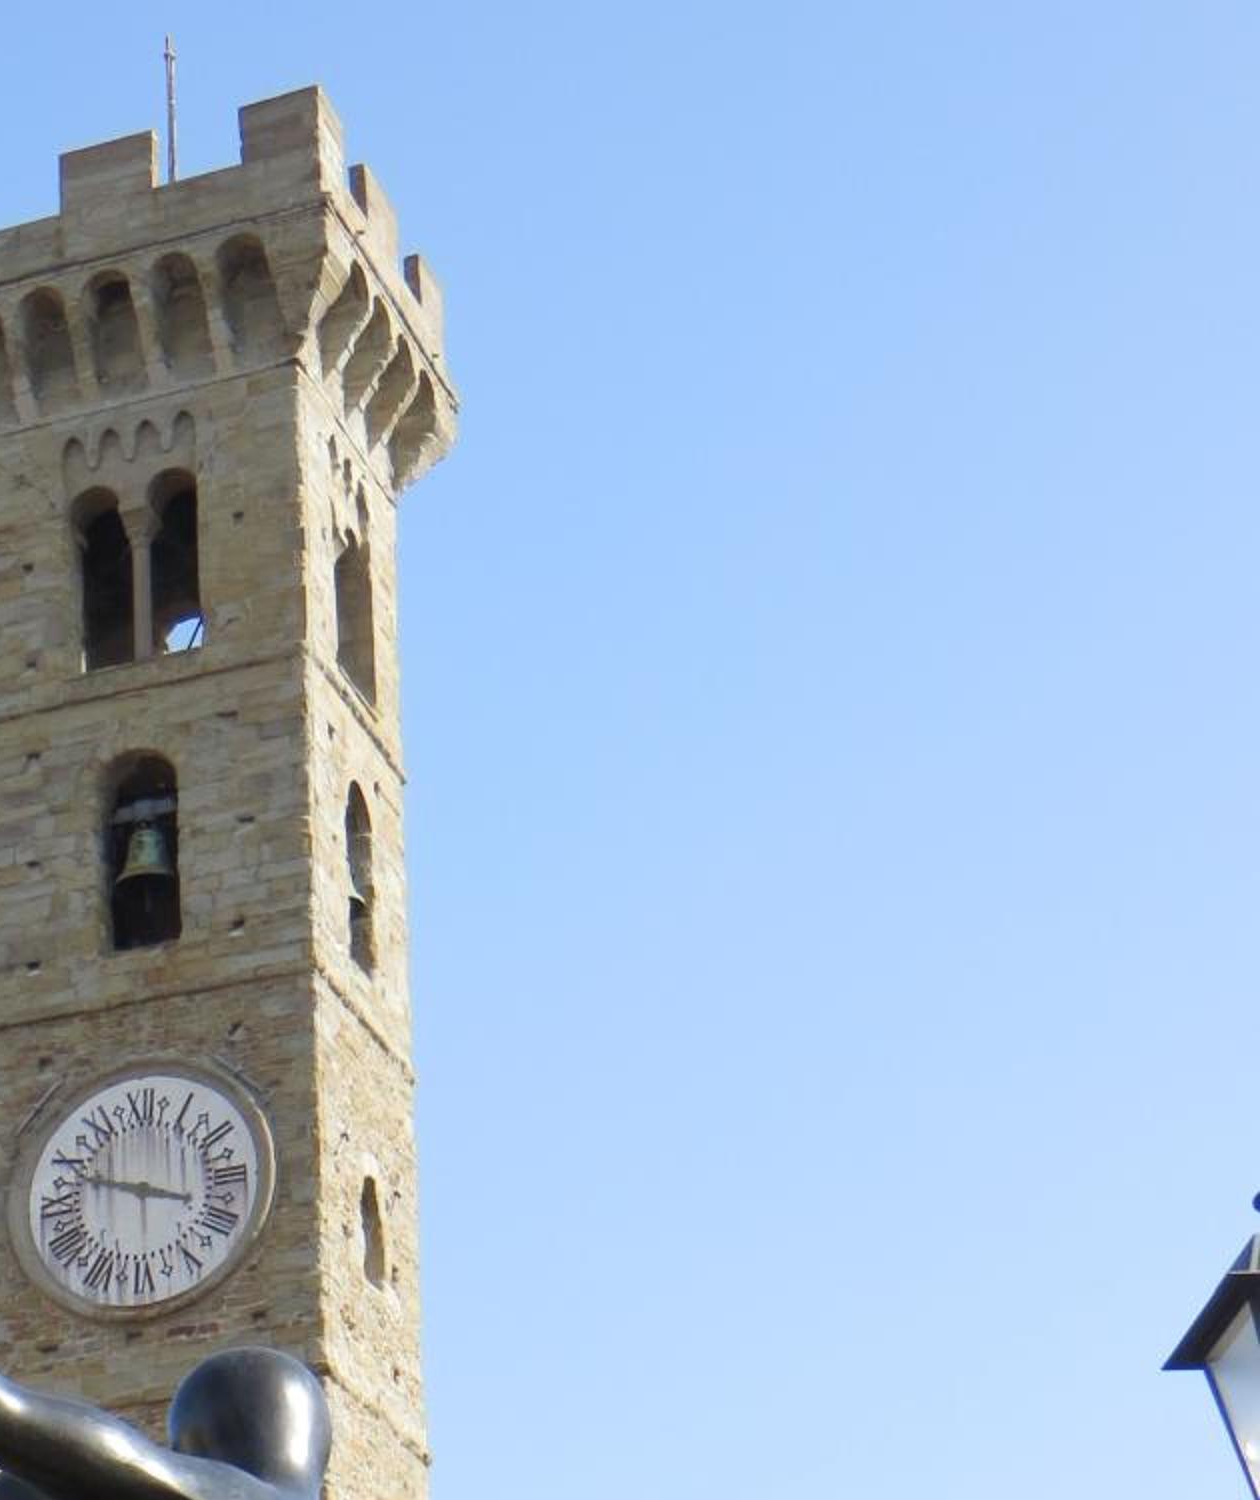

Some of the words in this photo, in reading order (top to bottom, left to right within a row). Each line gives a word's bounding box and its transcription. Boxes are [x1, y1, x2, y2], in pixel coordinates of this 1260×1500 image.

[202, 1120, 236, 1148] II
[52, 1149, 84, 1178] X
[213, 1164, 246, 1186] III
